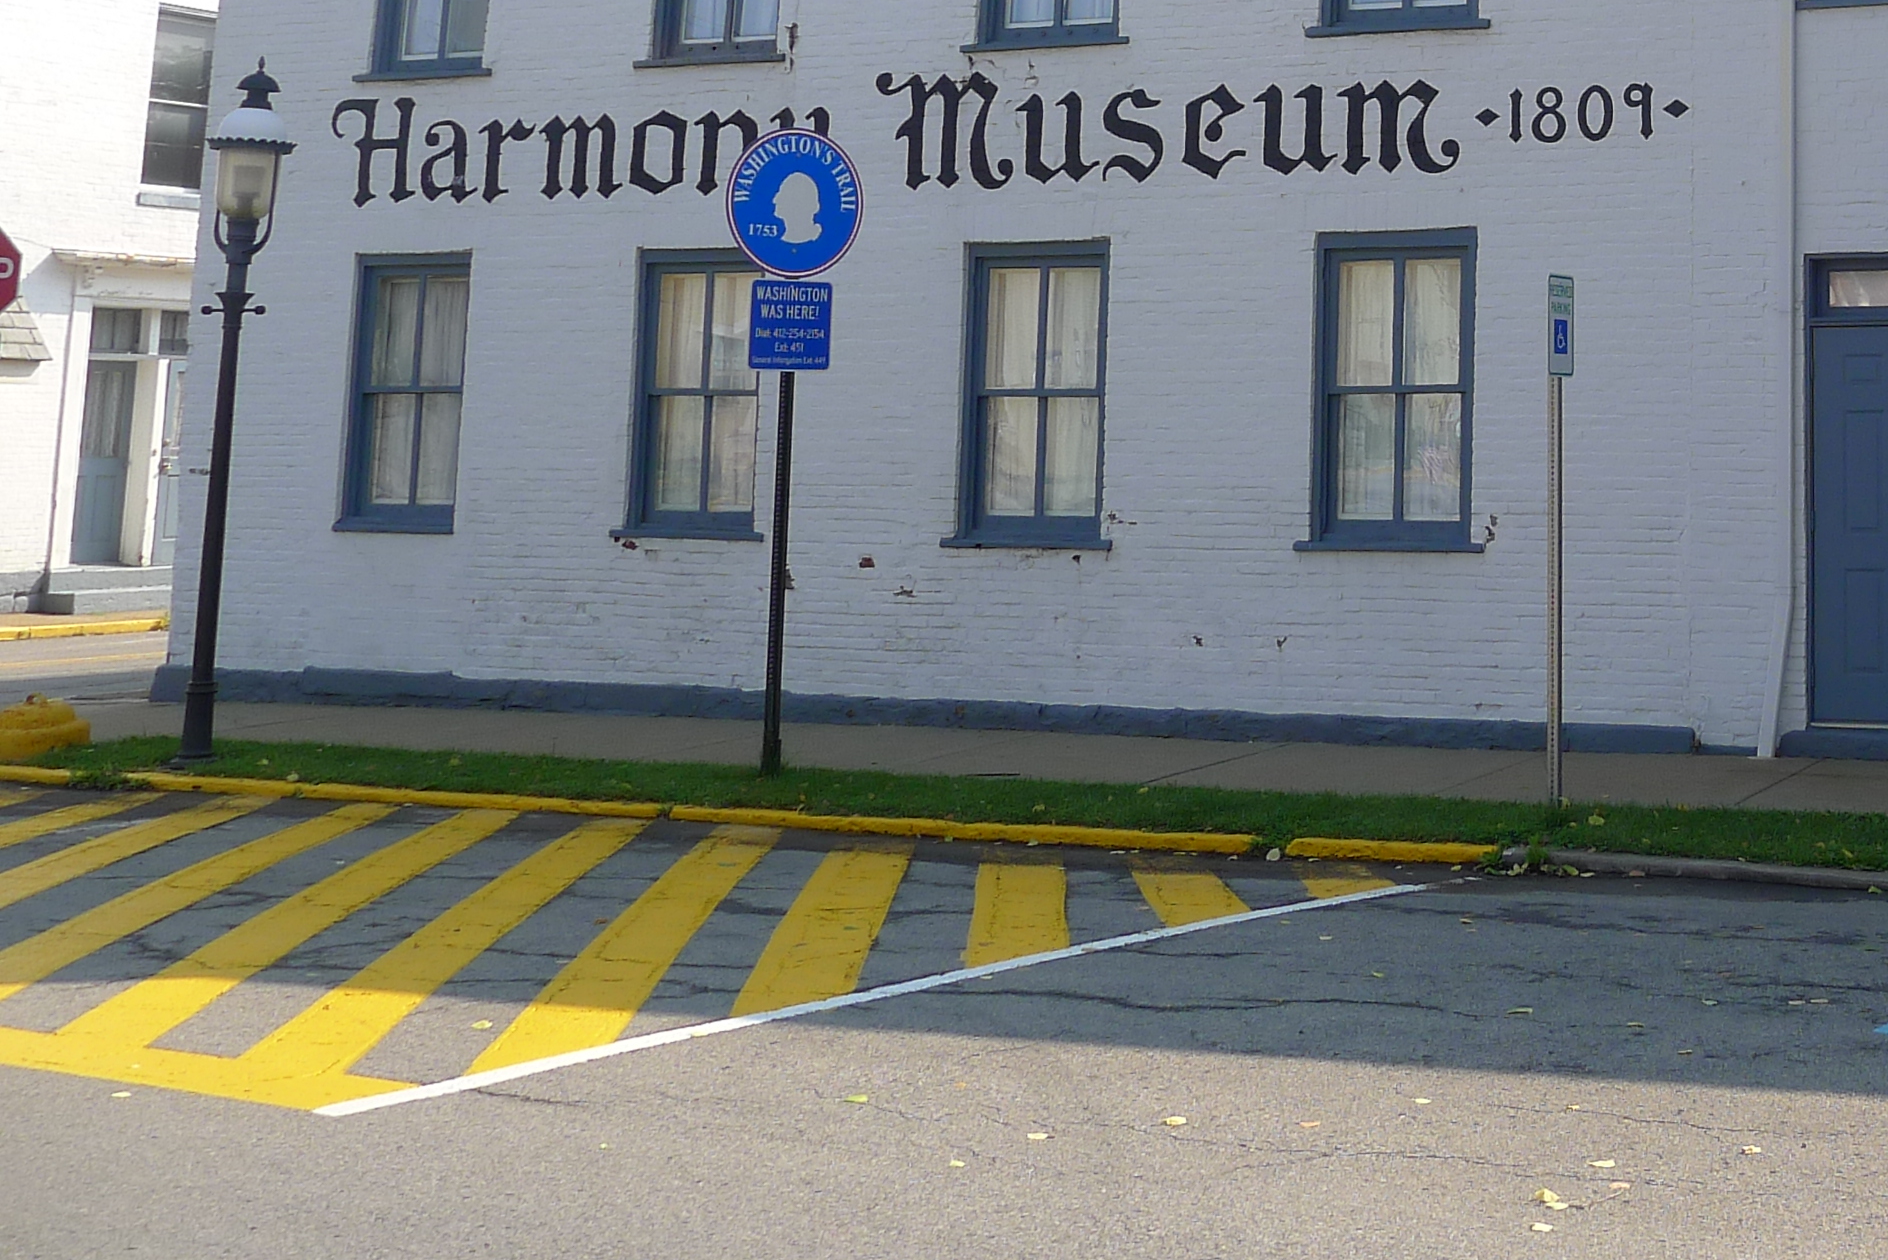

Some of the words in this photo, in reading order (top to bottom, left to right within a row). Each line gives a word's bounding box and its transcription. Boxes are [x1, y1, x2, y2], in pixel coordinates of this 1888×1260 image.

[332, 97, 831, 207] Harmon
[876, 71, 1461, 191] Museum
[734, 136, 836, 202] WASHINGTON'S
[831, 161, 856, 212] TRAIL
[748, 223, 778, 237] 1753
[756, 286, 828, 302] WASHINGTON
[761, 304, 784, 319] WAS
[786, 304, 820, 320] HERE!
